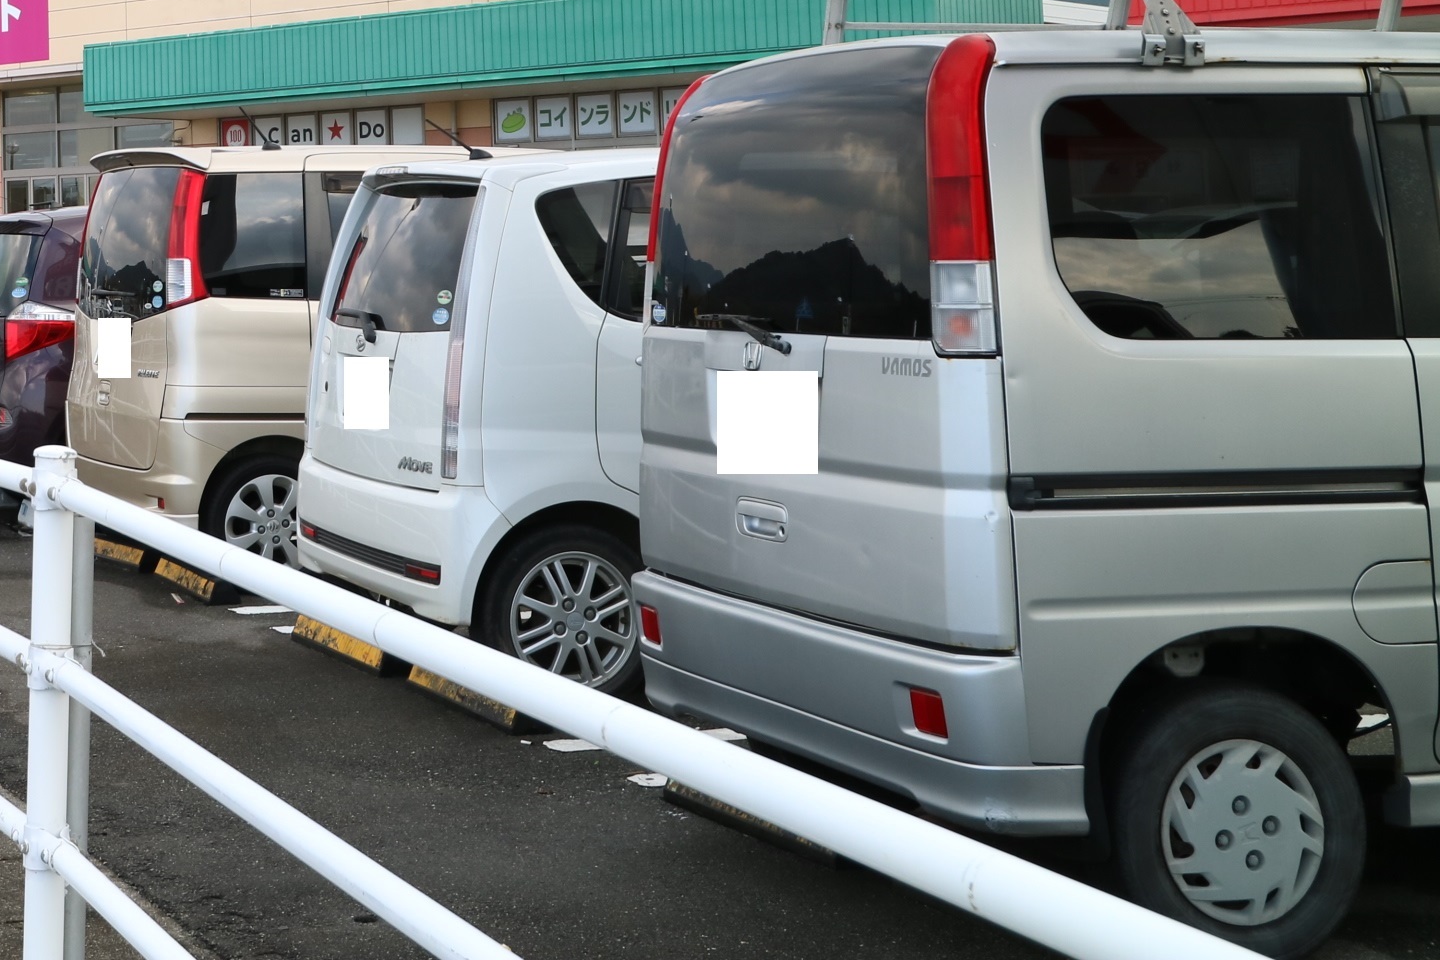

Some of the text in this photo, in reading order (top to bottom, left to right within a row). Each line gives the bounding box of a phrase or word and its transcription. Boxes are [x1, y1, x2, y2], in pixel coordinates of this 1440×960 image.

[359, 121, 385, 139] Do
[881, 356, 933, 378] VAMOS
[397, 456, 433, 474] MOVE
